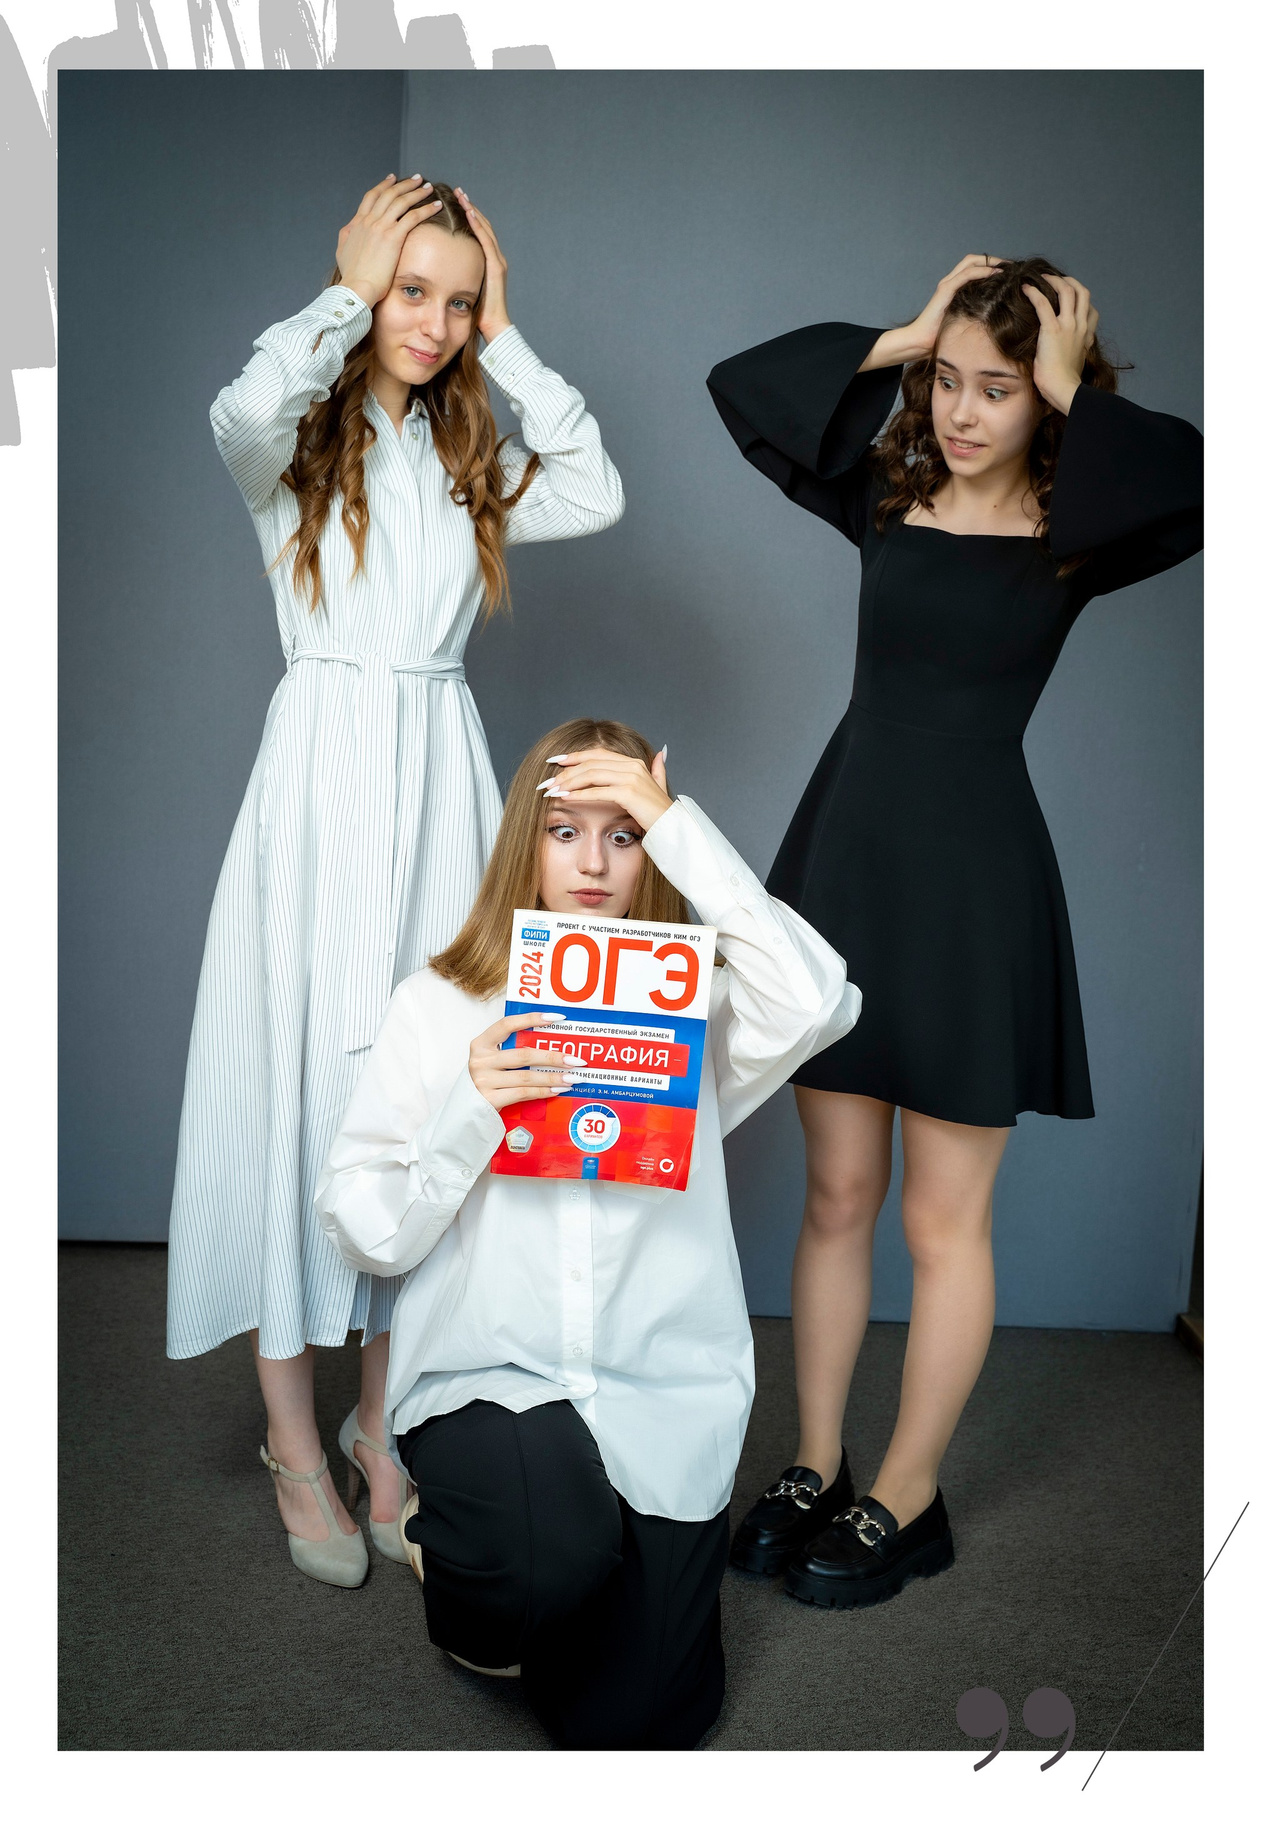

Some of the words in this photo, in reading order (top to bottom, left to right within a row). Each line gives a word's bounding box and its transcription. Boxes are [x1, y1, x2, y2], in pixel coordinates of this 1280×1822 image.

[524, 930, 548, 940] ФИПИ
[557, 922, 579, 930] ПРОЕКТ
[588, 925, 620, 934] УЧАСТИЕМ
[622, 928, 672, 939] РАЗРАБОТЧИКОВ
[518, 951, 544, 999] 2024
[550, 933, 700, 1011] ОГЭ
[575, 1026, 637, 1036] ГОСУДАРСТВЕННЫЙ
[640, 1031, 669, 1039] ЭКЗАМЕН
[536, 1039, 669, 1068] ГЕОГРАФИЯ
[630, 1076, 662, 1085] ВАРИАНТЫ
[611, 1090, 654, 1099] АМБАРЦУМОВОЙ
[584, 1119, 605, 1134] 30
